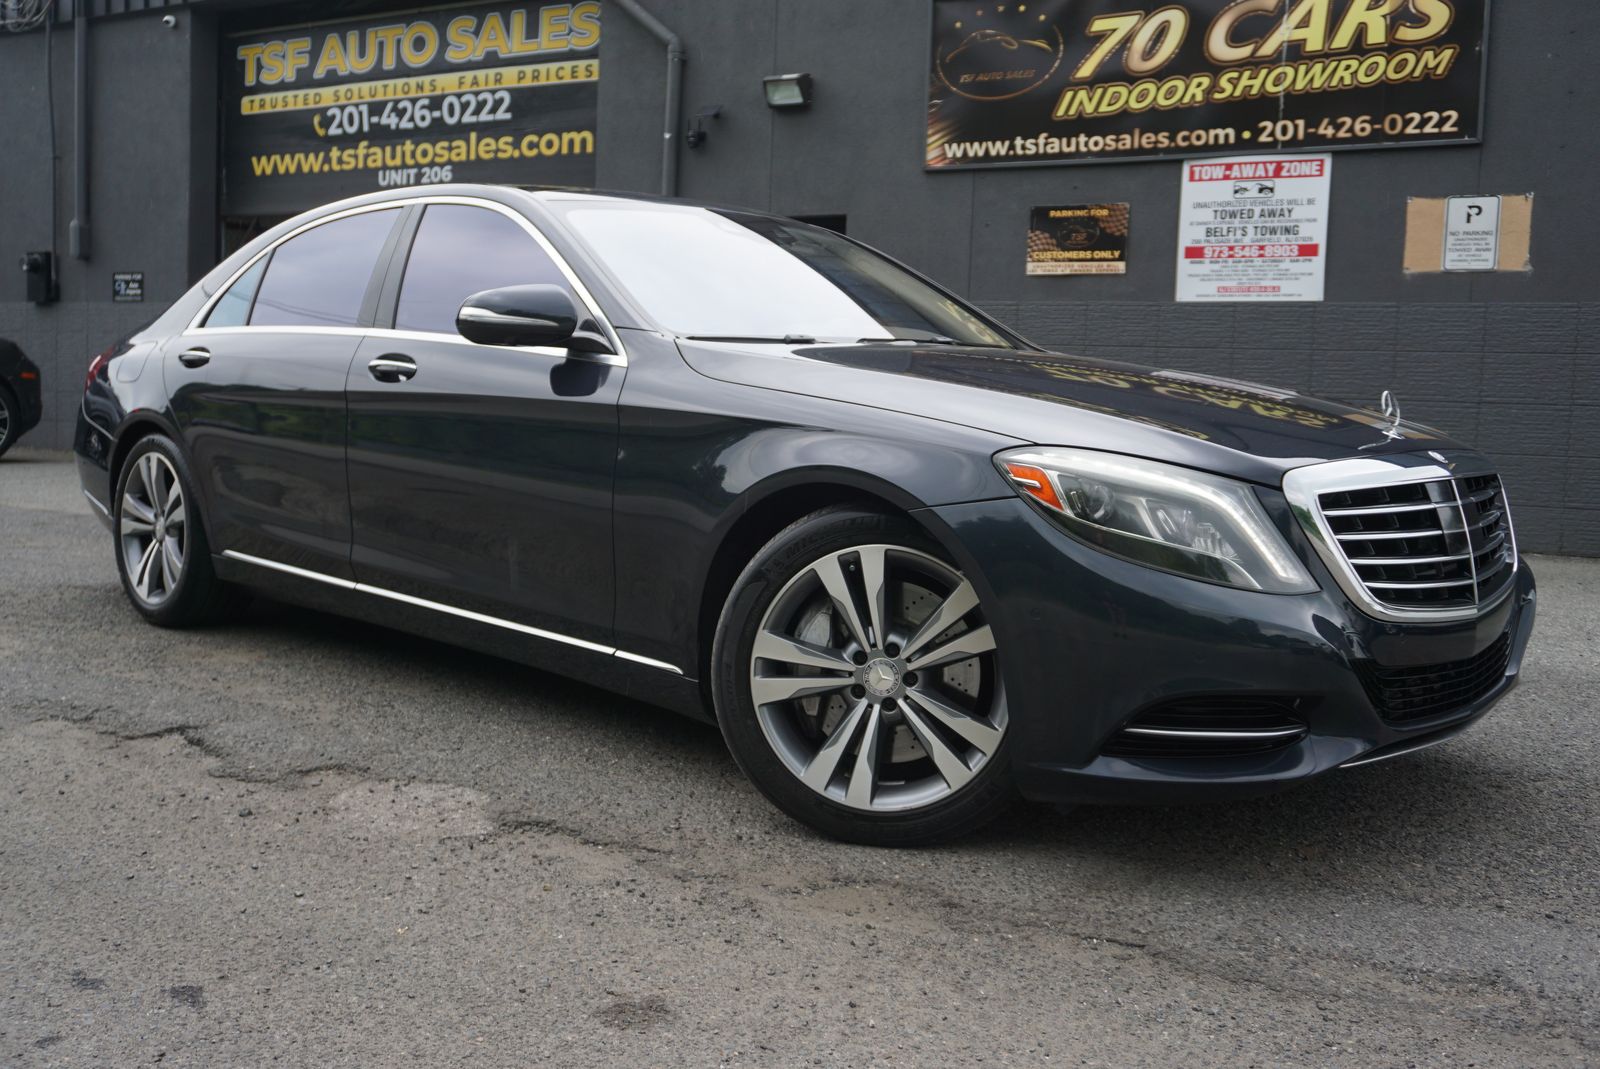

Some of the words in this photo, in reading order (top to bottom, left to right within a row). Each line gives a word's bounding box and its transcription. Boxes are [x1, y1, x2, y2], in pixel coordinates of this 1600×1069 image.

[237, 37, 312, 87] TSF
[313, 21, 440, 79] AUTO
[445, 1, 601, 63] SALES
[1072, 6, 1189, 81] 70
[1206, 0, 1454, 63] CARS
[248, 92, 321, 111] TRUSTED
[333, 79, 445, 102] SOLUTIONS,
[458, 72, 503, 89] FAIR
[517, 64, 593, 83] PRICES
[1053, 74, 1213, 119] INDOOR
[1210, 45, 1460, 101] SHOWROOM
[327, 90, 512, 136] 201-426-0222
[944, 127, 1236, 158] www.tsfautosales.com
[1257, 110, 1459, 143] 201-426-0222
[251, 130, 594, 176] www.tsfautosales.com
[1192, 163, 1276, 180] TOW-AWAY
[1281, 160, 1321, 176] ZONE
[378, 168, 418, 187] UNIT
[421, 165, 453, 184] 206
[1050, 210, 1089, 218] PARKING
[1091, 209, 1109, 217] FOR
[1213, 209, 1255, 220] TOWED
[1259, 207, 1294, 219] AWAY
[1205, 226, 1248, 238] BELFI'S
[1254, 224, 1299, 237] TOWING
[1034, 250, 1092, 260] CUSTOMERS
[1093, 250, 1120, 259] ONLY
[1203, 245, 1299, 258] 973-546-8903
